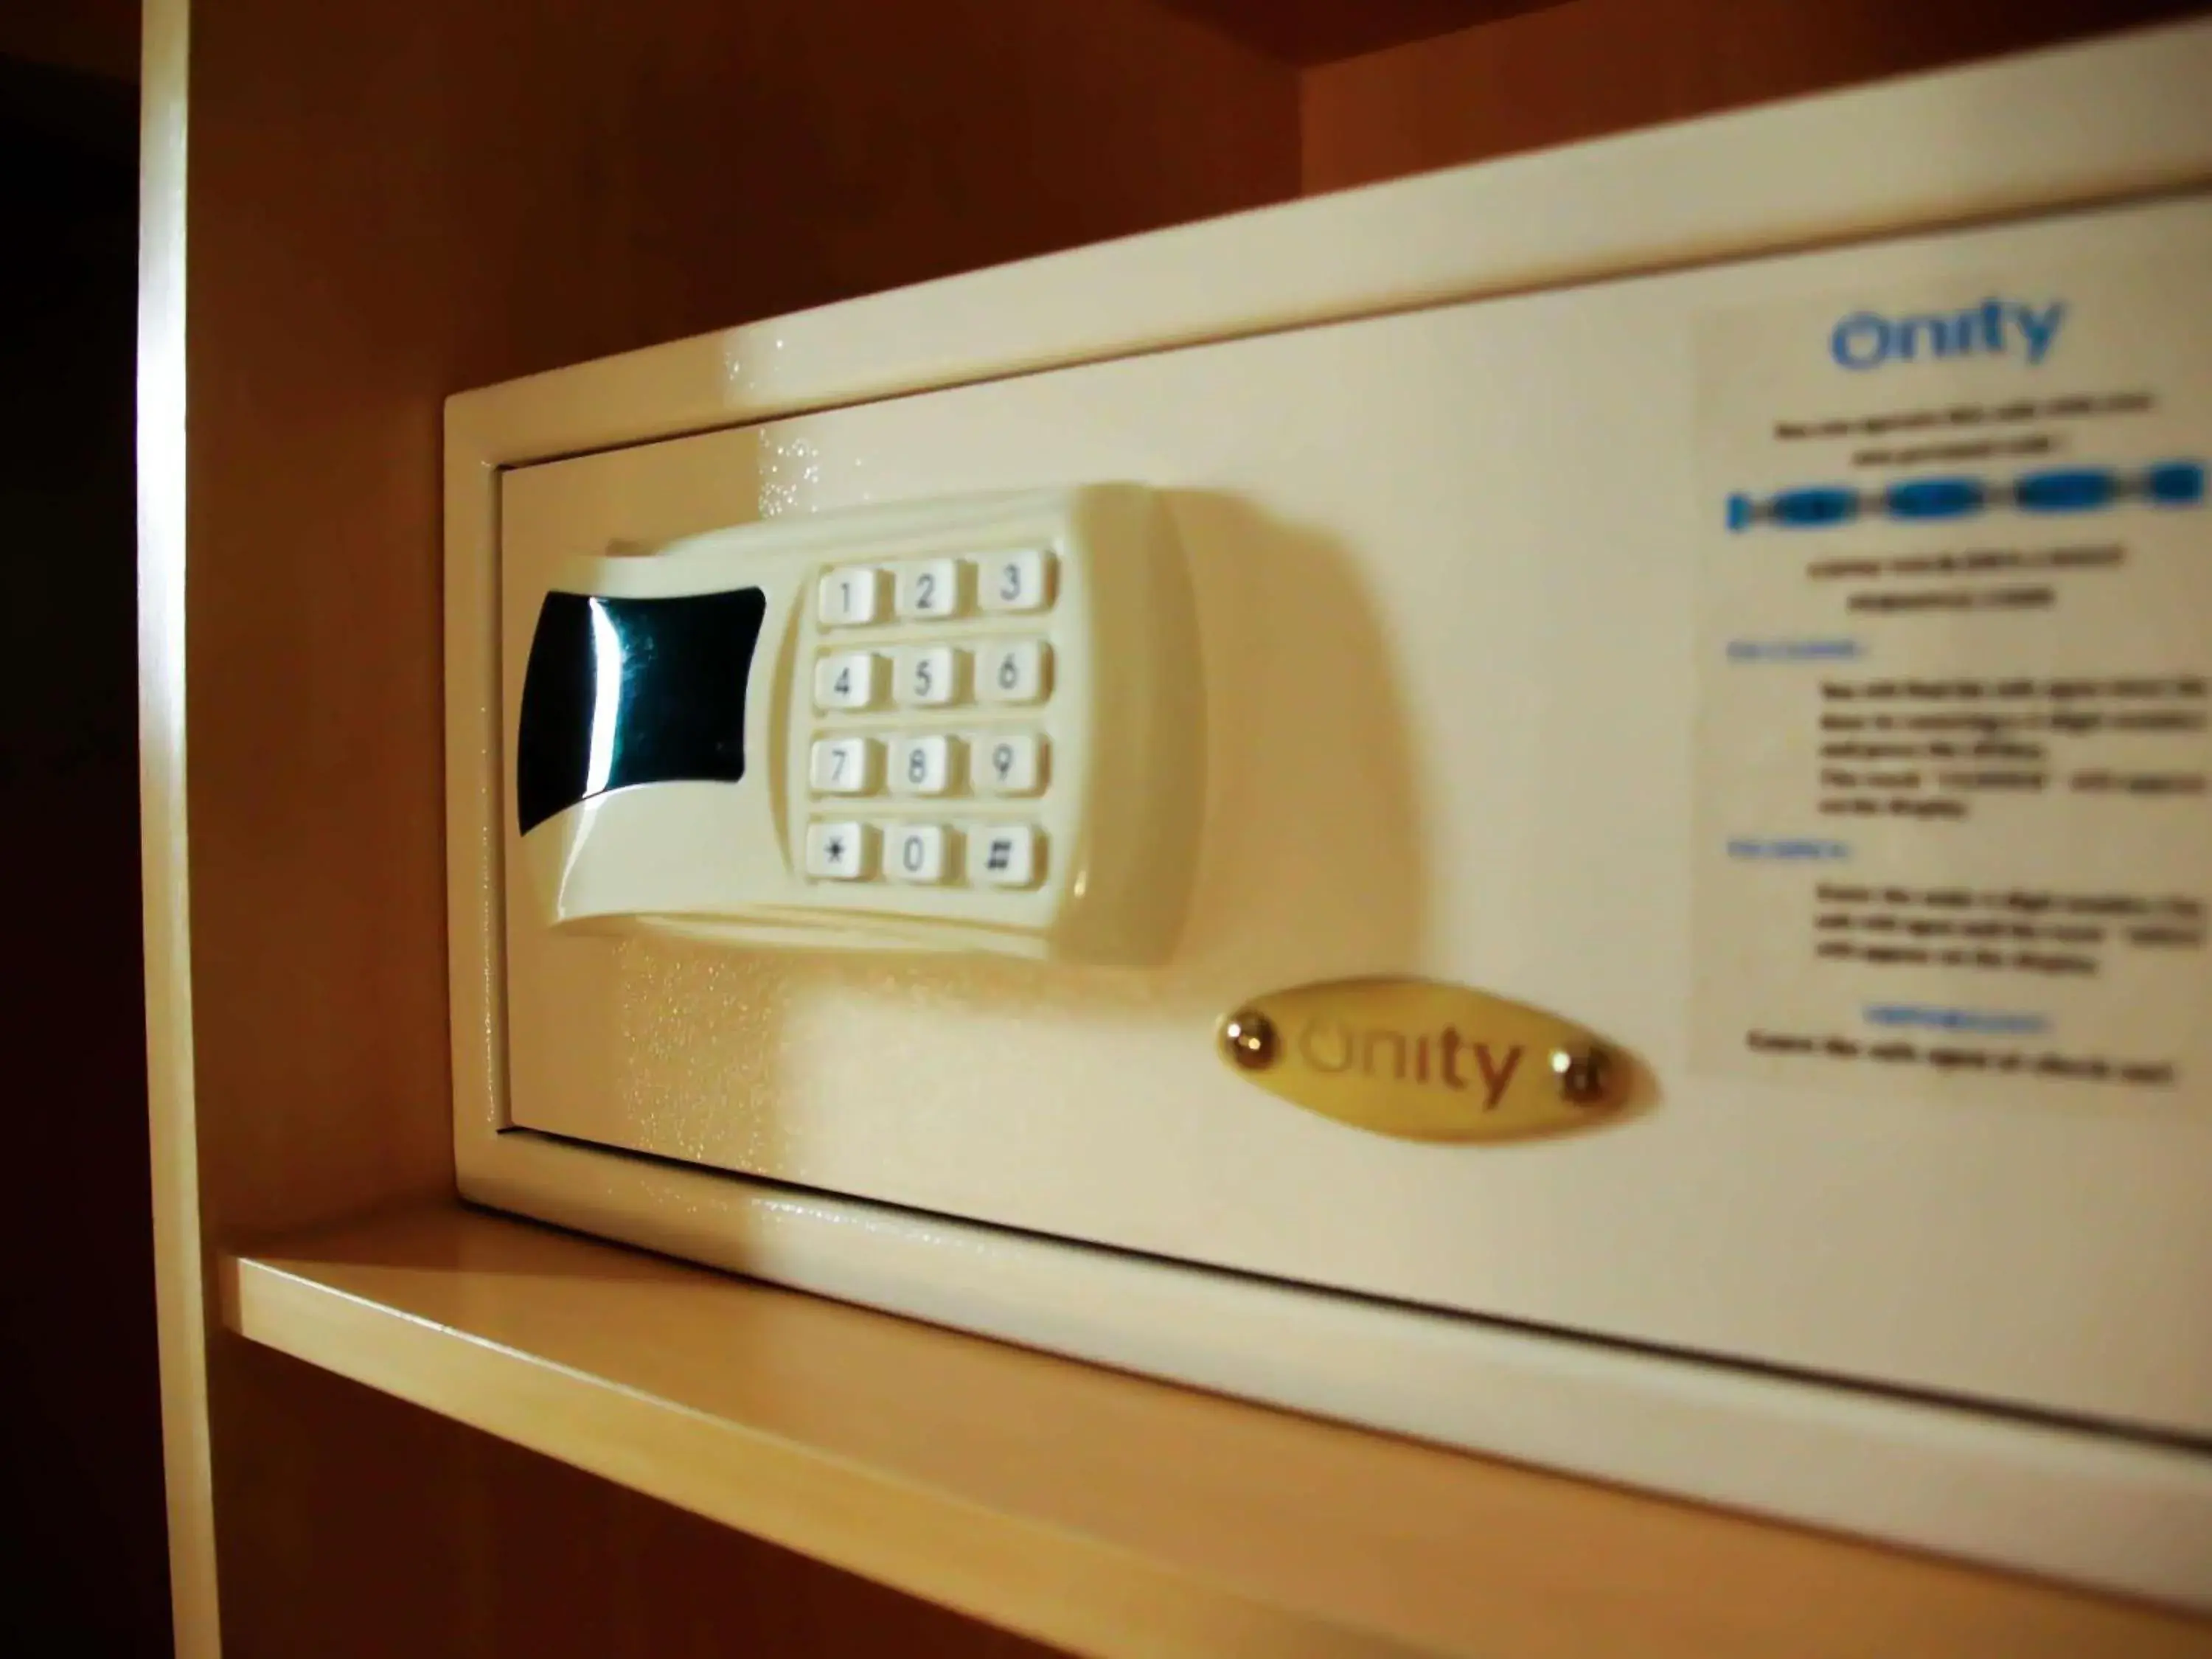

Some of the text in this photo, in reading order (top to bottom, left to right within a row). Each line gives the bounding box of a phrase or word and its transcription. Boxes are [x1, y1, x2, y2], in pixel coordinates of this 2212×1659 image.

[1830, 296, 2066, 369] Onity
[840, 563, 1022, 613] 1 2 3
[833, 653, 1018, 697] 4 5 6
[831, 743, 1014, 784] 7 8 9
[902, 835, 924, 872] 0
[986, 839, 1013, 869] #
[1298, 1015, 1523, 1110] Onity
